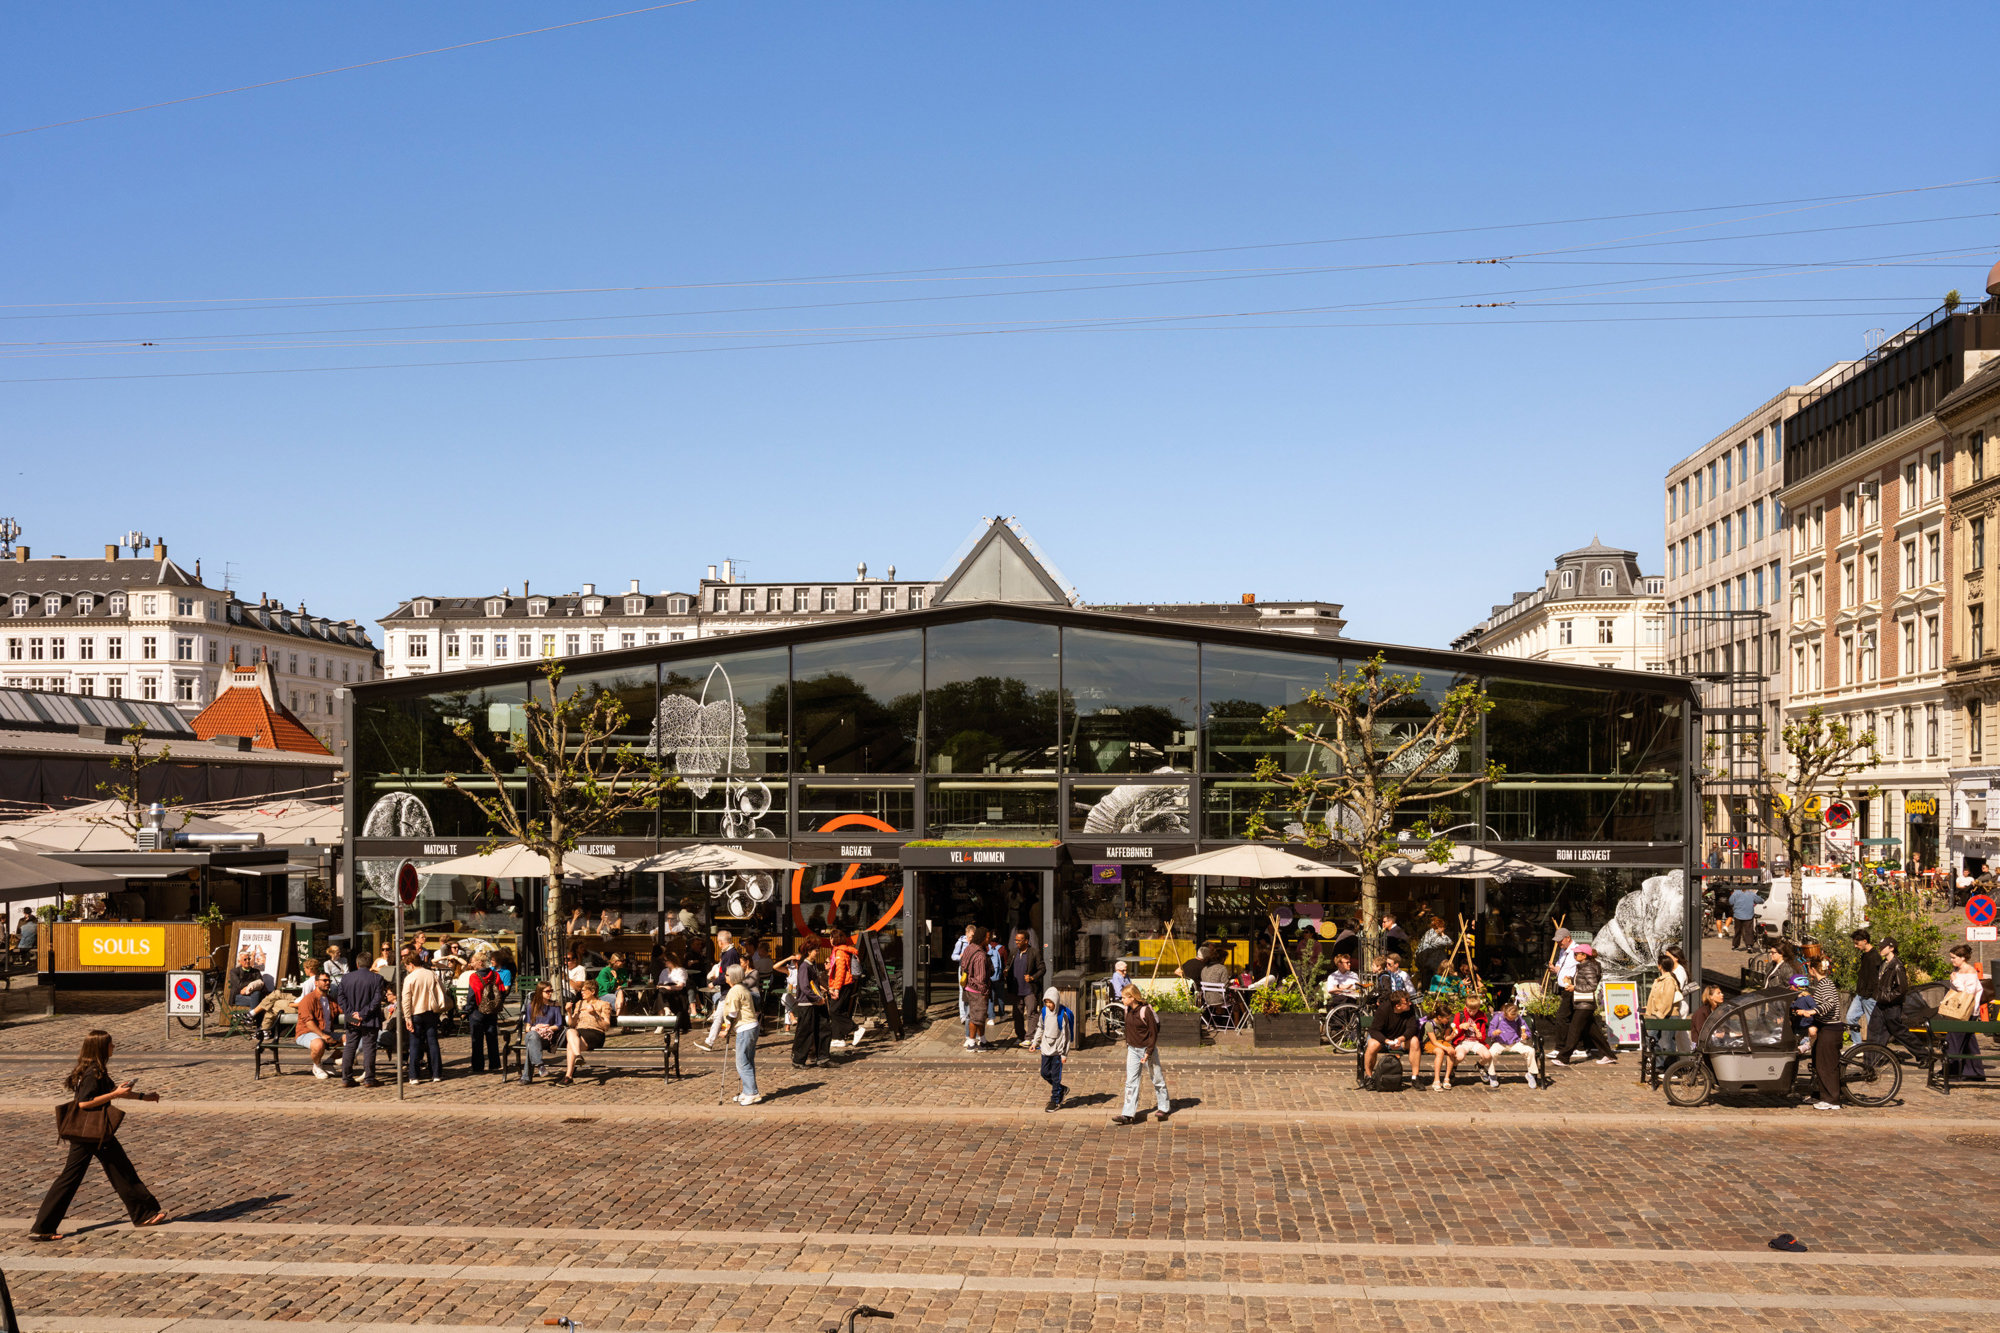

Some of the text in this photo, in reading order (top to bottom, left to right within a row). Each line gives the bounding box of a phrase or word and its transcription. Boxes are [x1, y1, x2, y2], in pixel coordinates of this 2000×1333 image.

[1905, 799, 1928, 814] Netto
[423, 844, 458, 855] MATCHA TE
[841, 845, 872, 857] BAGVÆRK
[1106, 846, 1153, 858] KAFFEBØNNER
[1556, 849, 1573, 861] ROM
[1578, 849, 1611, 861] LØSVÆGT
[950, 851, 963, 863] VEL
[973, 851, 1005, 863] KOMMEN
[93, 938, 150, 955] SOULS
